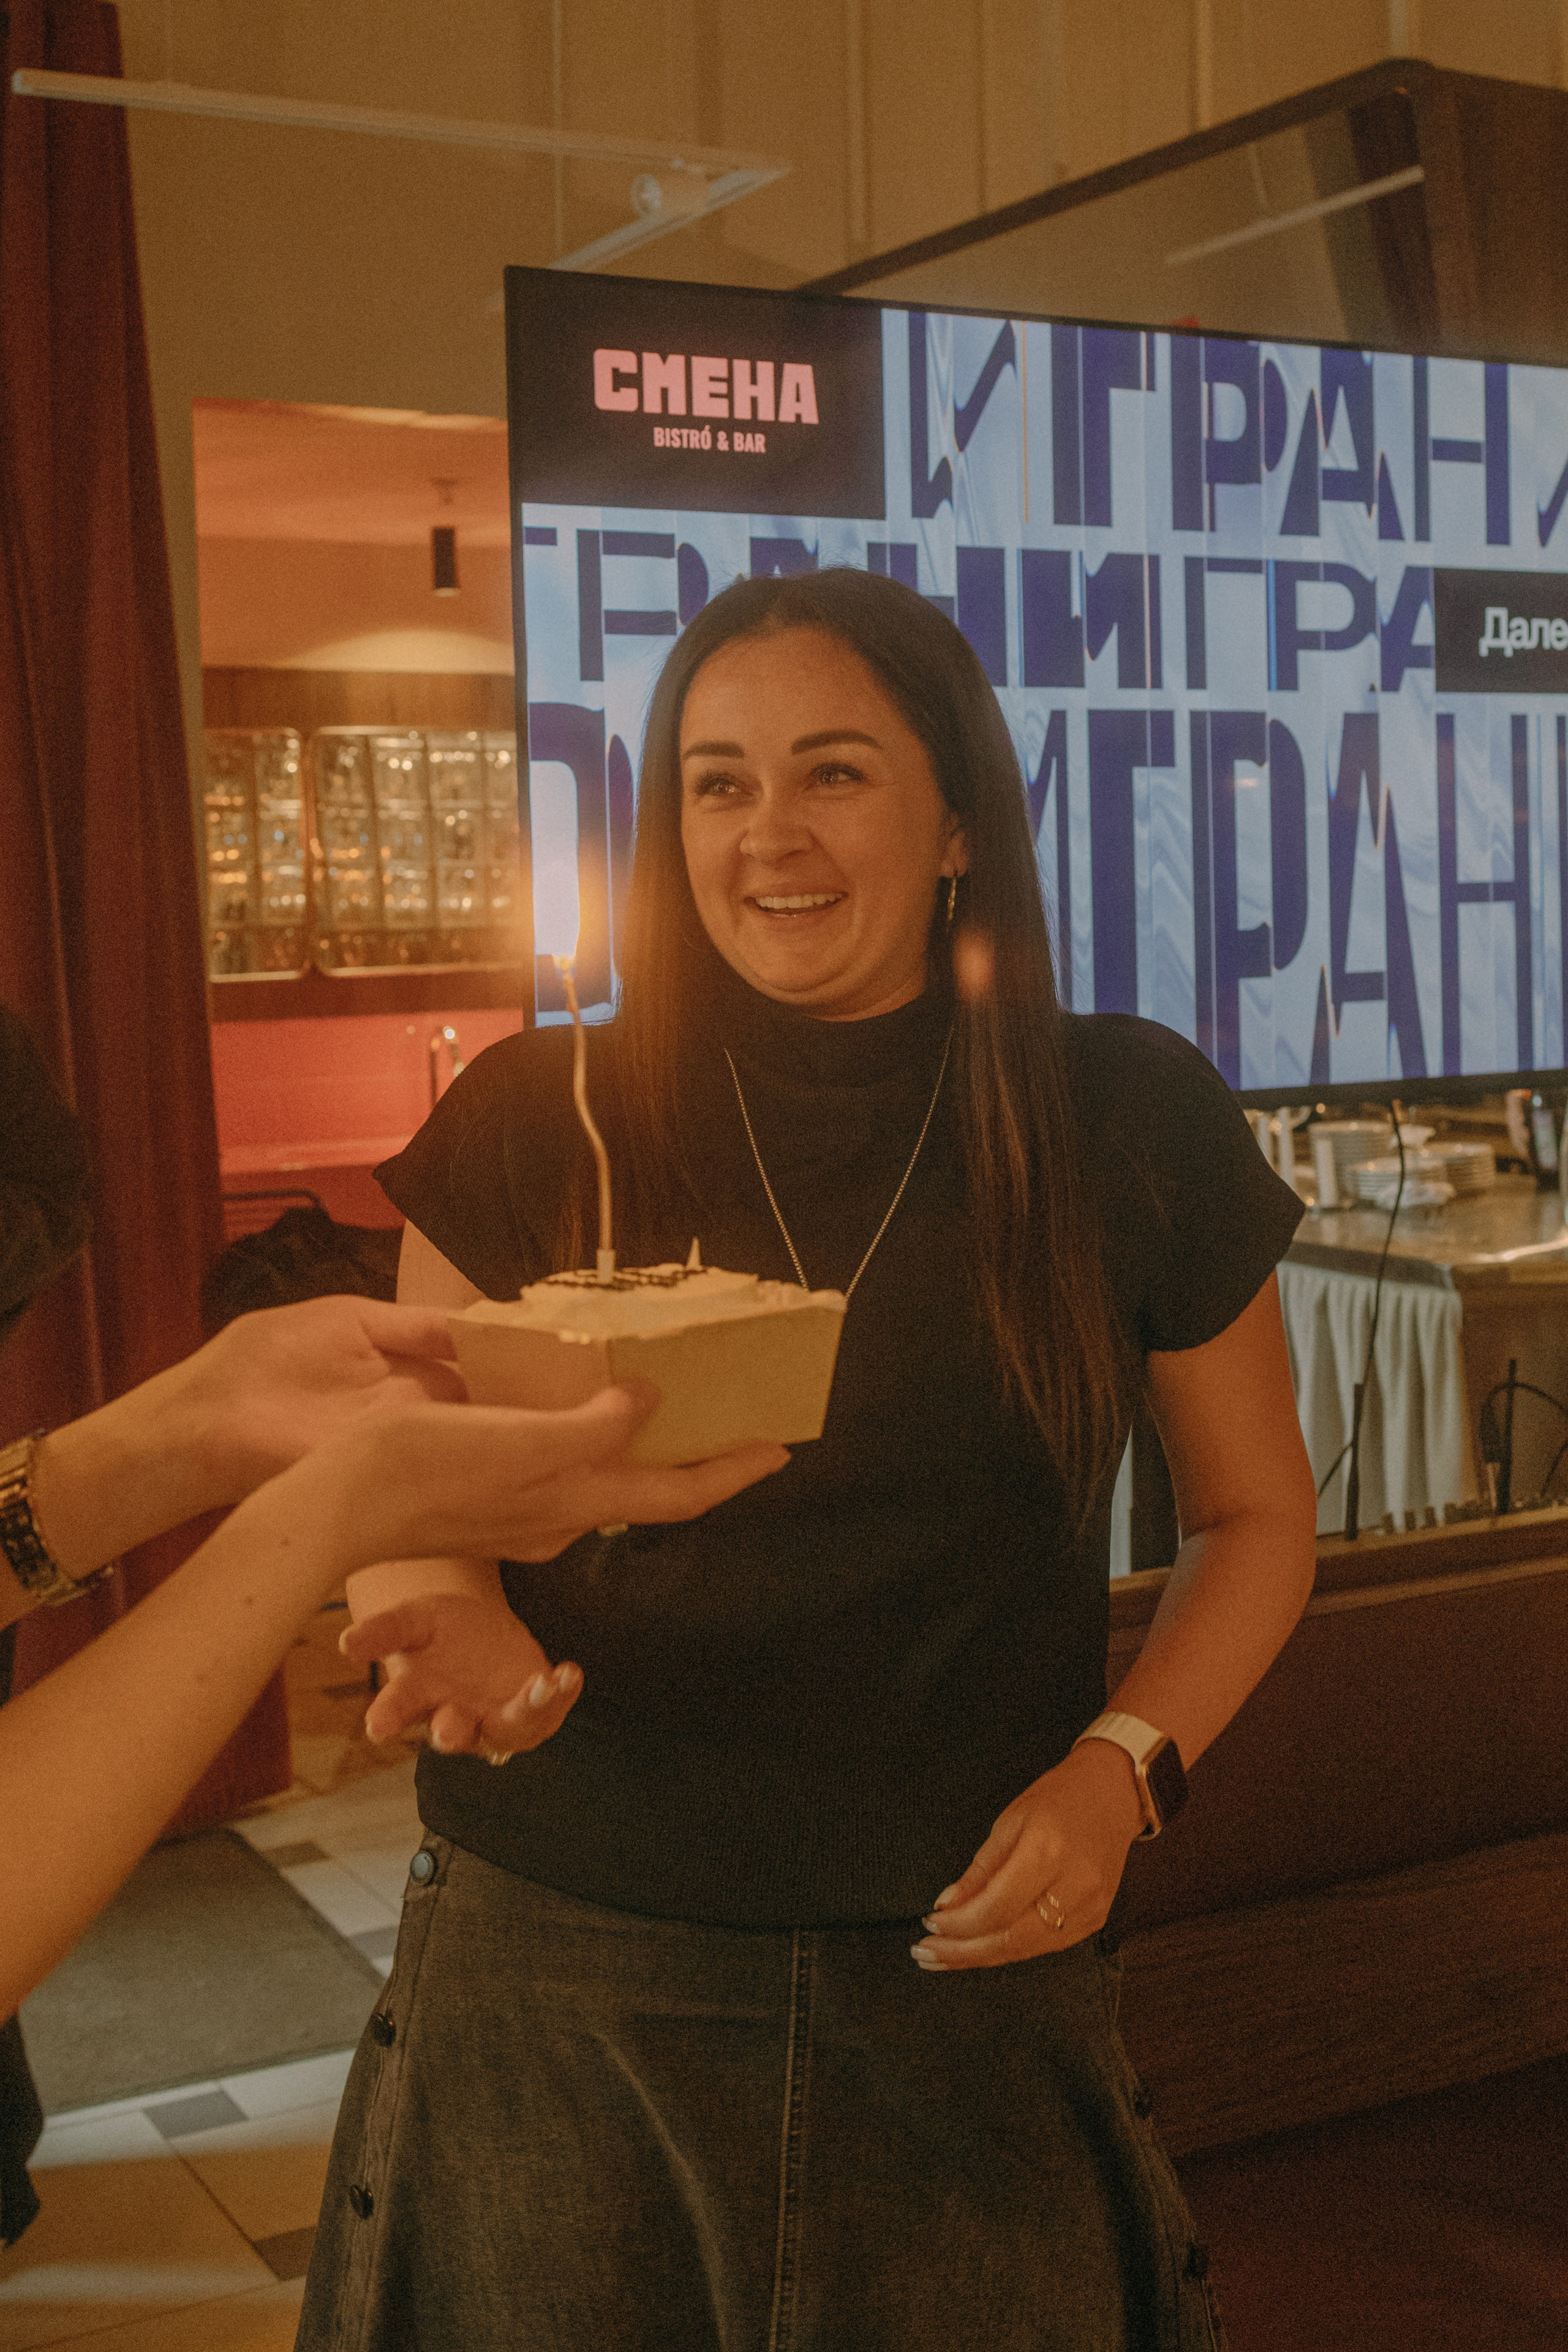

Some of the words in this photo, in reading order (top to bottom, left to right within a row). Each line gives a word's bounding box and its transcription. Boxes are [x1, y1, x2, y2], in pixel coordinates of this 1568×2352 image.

[593, 348, 820, 424] СМЕНА
[654, 424, 712, 450] BISTRÓ
[717, 431, 729, 451] &
[733, 431, 766, 453] BAR
[1478, 606, 1568, 658] Дале
